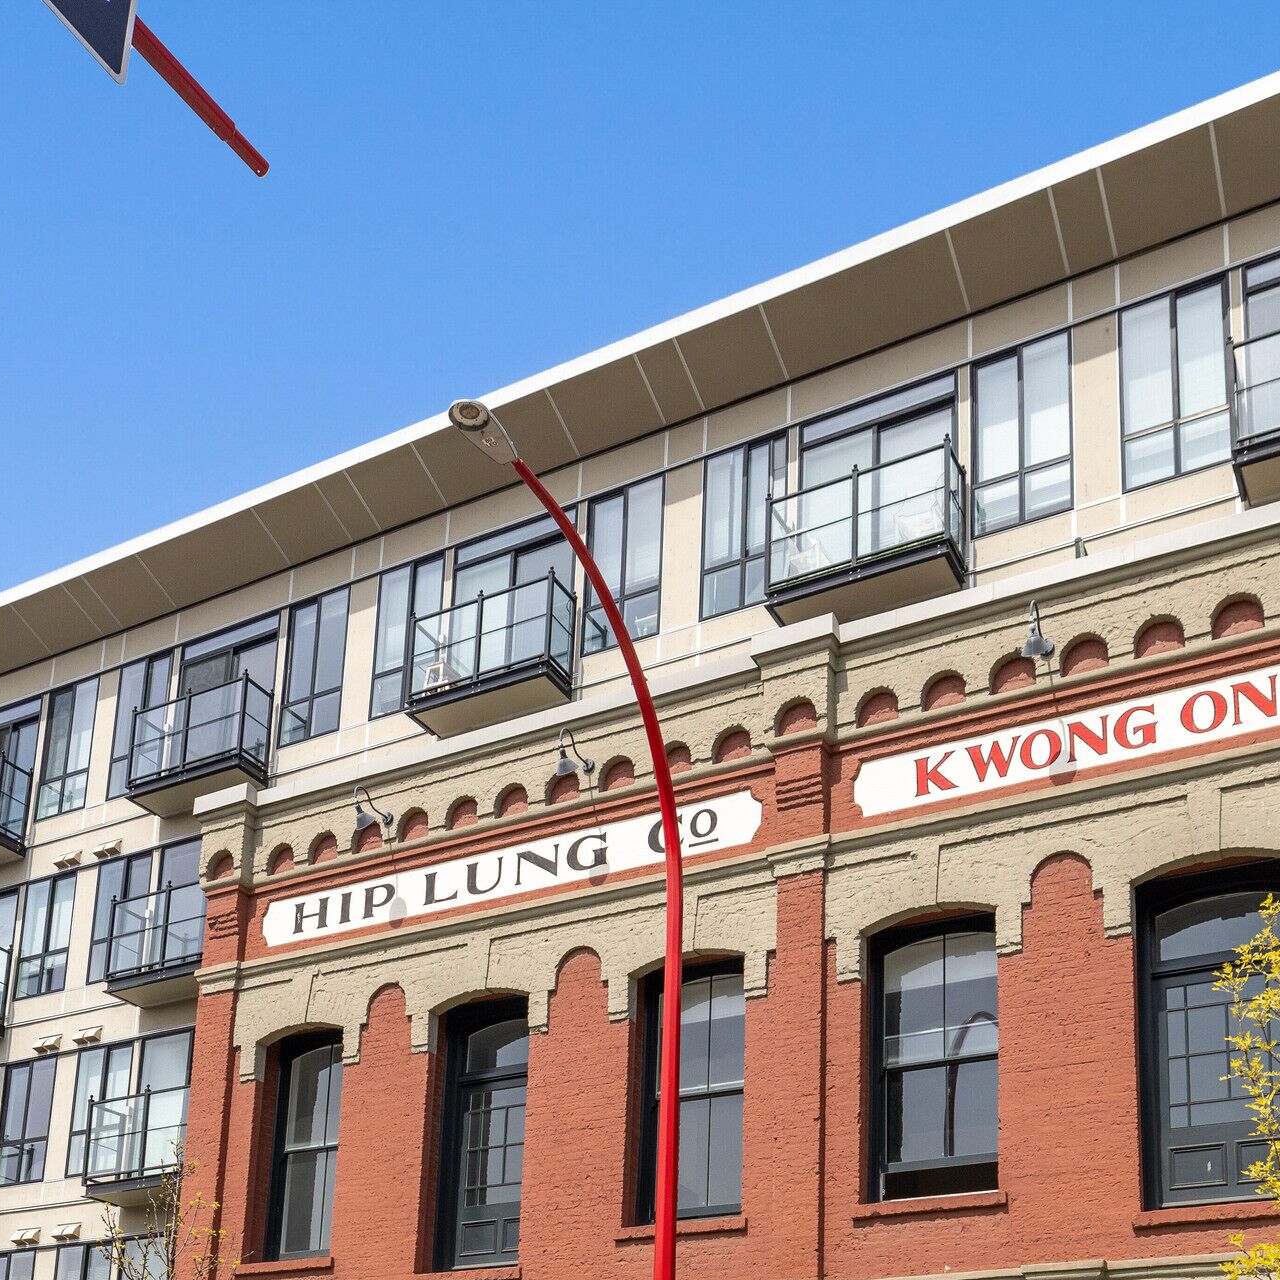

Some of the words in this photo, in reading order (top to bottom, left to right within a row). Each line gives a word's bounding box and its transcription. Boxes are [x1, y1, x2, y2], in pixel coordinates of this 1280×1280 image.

[914, 702, 1159, 798] KWONG
[1180, 674, 1279, 735] ON
[293, 882, 397, 935] HIP
[424, 830, 609, 906] LUNG
